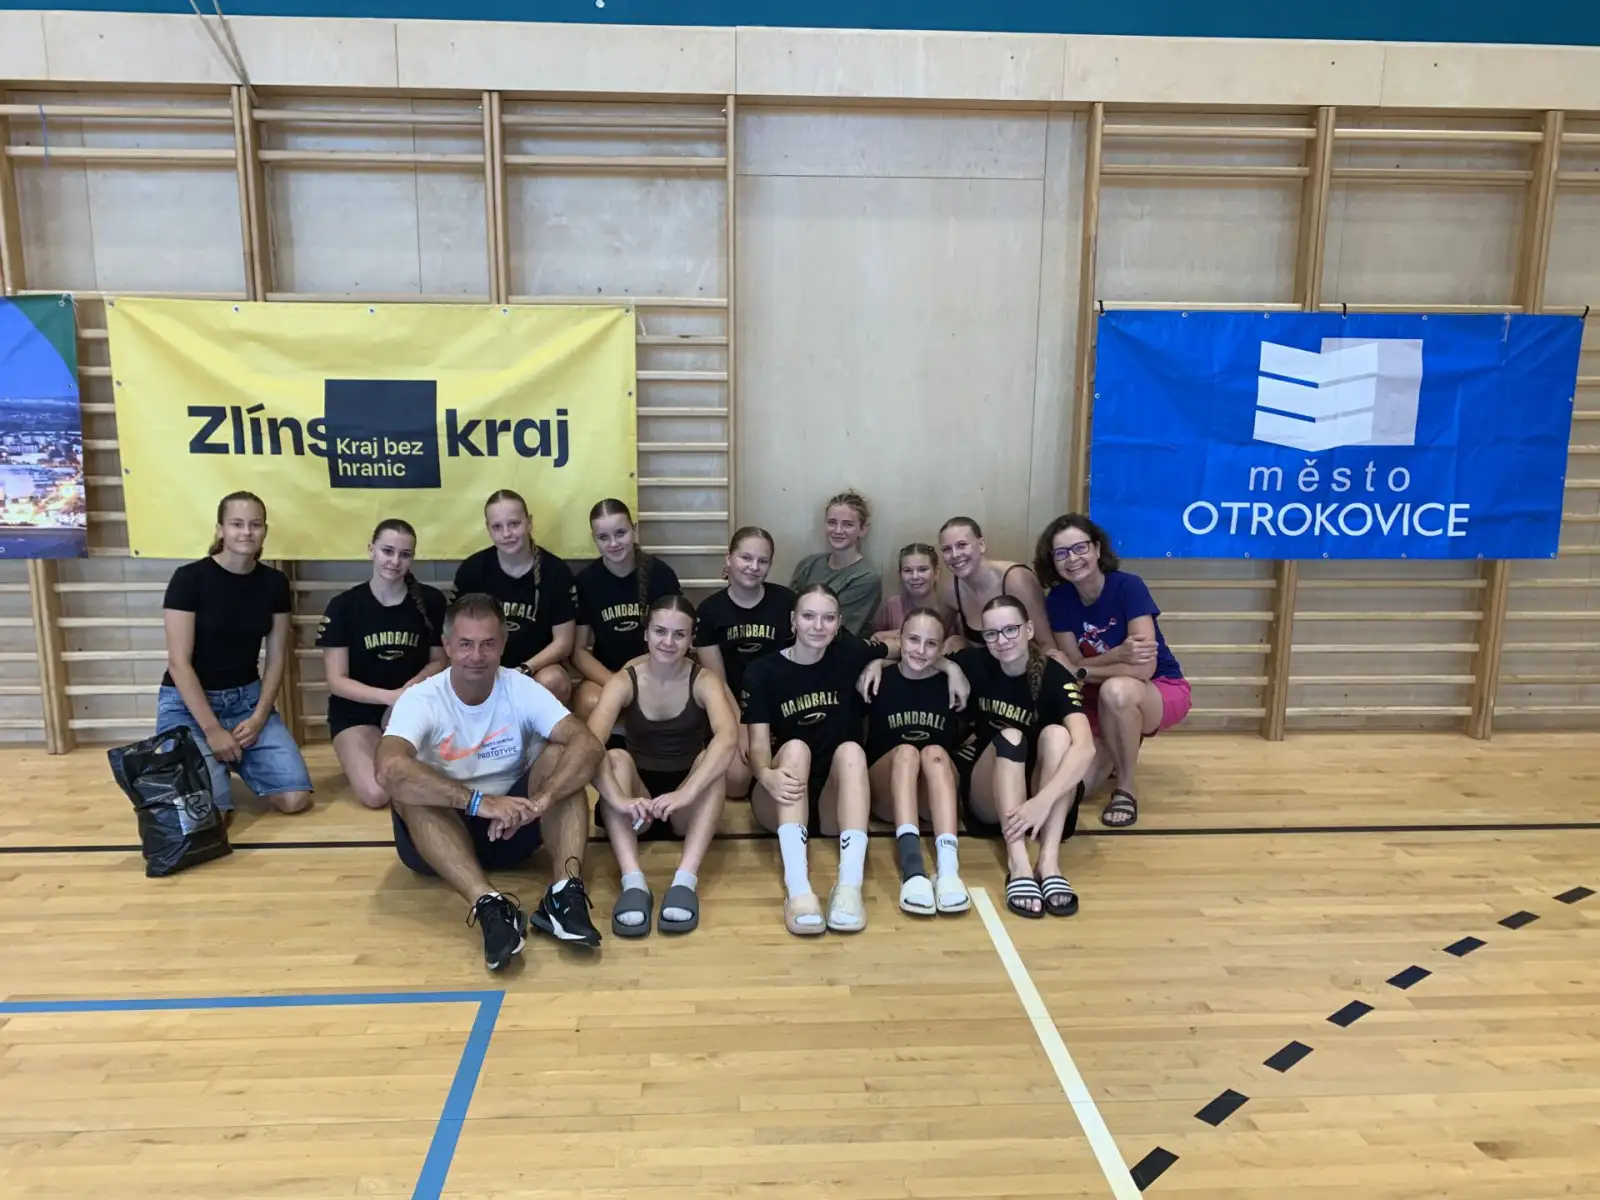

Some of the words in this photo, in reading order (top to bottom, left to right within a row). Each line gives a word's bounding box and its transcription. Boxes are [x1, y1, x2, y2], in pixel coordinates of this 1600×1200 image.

[336, 437, 379, 459] Kraj
[384, 439, 424, 456] bez
[445, 408, 569, 468] kraj
[338, 458, 407, 477] hranic
[1248, 458, 1411, 492] město
[1182, 500, 1470, 536] OTROKOVICE
[500, 601, 537, 622] DBALL
[364, 631, 420, 650] HANDBALL
[727, 623, 776, 641] HANDBALL
[781, 690, 840, 718] HANDBALL
[978, 697, 1033, 727] HANDBALL
[887, 710, 946, 730] HANDBALL
[477, 745, 518, 760] PROTOTYPE
